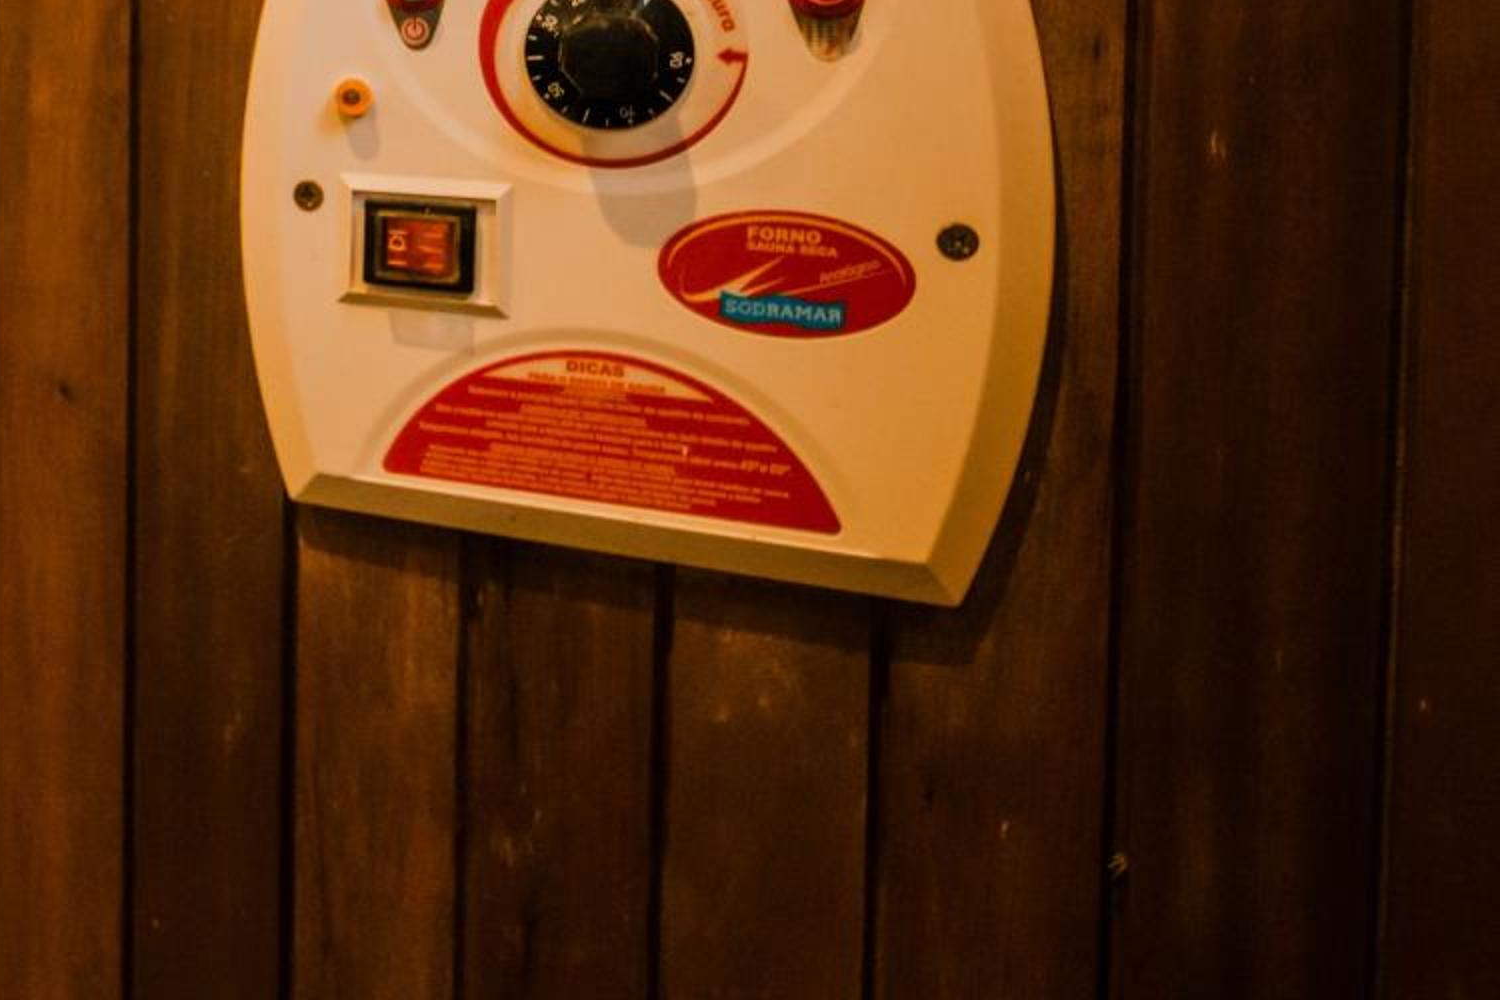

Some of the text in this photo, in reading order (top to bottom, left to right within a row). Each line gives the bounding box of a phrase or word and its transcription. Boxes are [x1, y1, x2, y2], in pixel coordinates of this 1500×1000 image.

[746, 225, 822, 246] FORNO
[724, 298, 843, 326] SODRAMAR
[565, 360, 626, 378] DICAS
